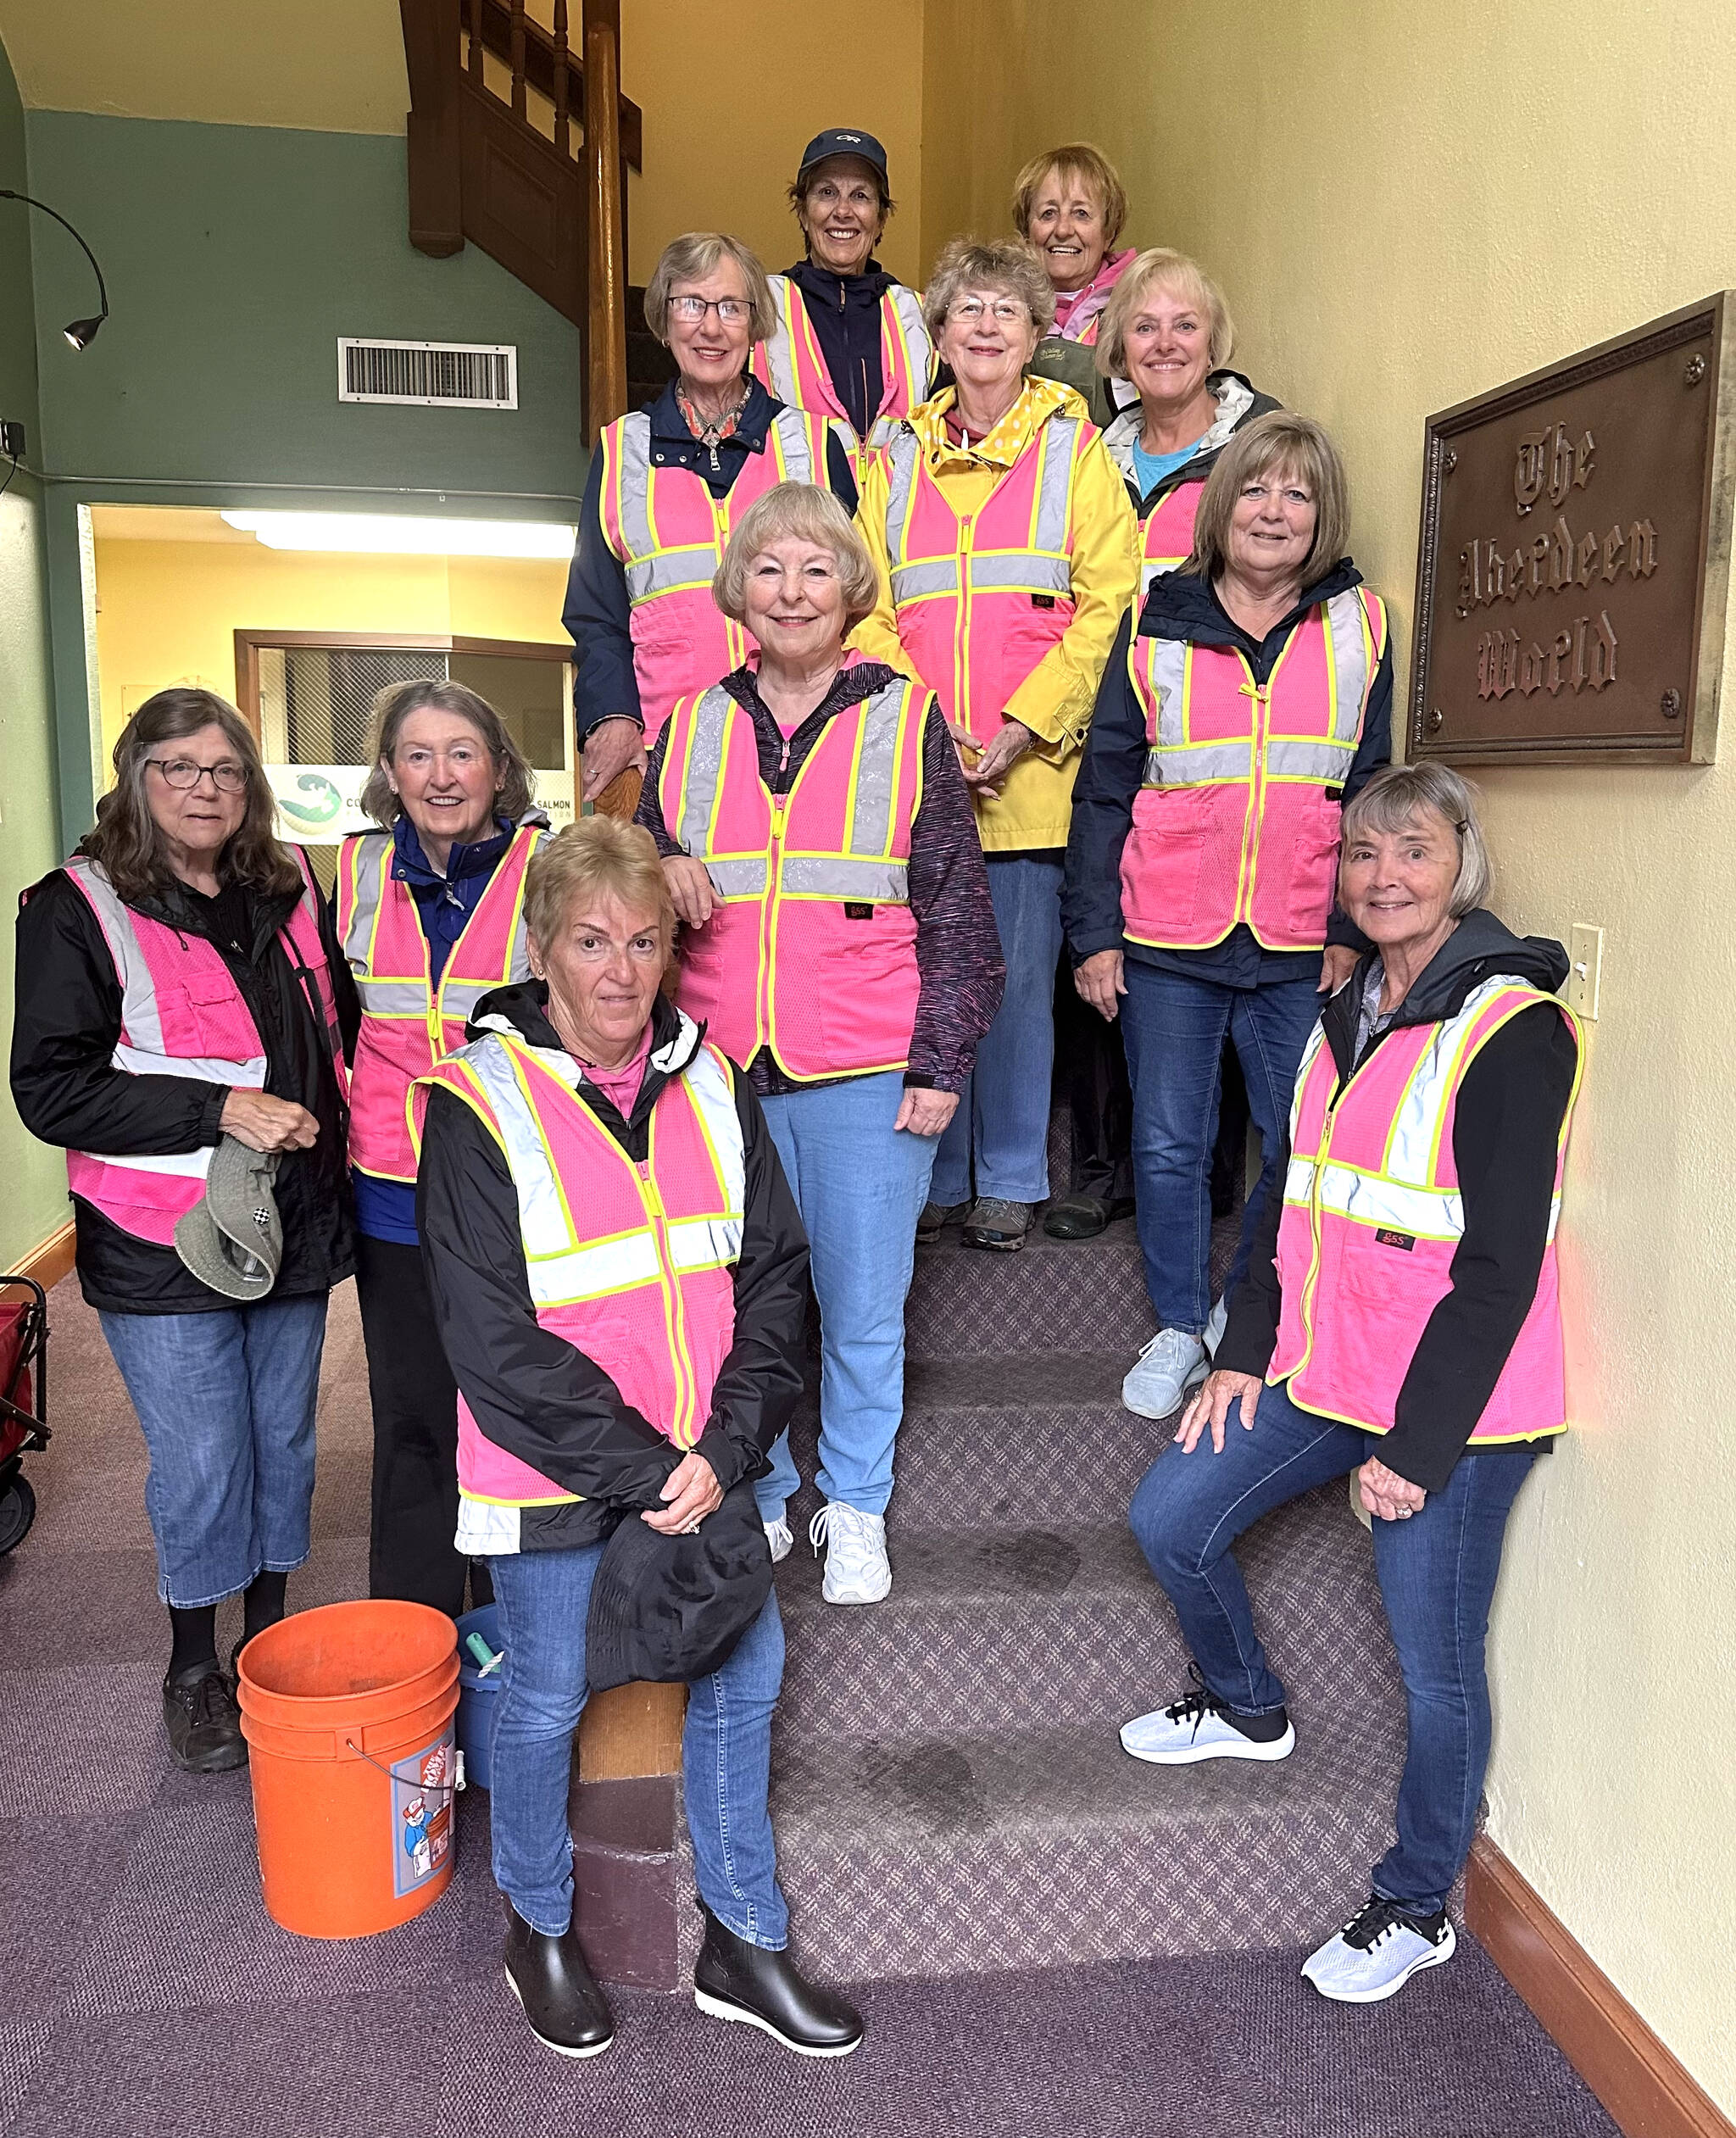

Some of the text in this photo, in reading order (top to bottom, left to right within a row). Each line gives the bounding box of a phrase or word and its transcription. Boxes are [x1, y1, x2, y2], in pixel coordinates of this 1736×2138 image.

[1515, 420, 1595, 515] The
[1455, 514, 1658, 618] Aberdeen
[1477, 610, 1618, 701] World
[537, 800, 570, 809] SALMON
